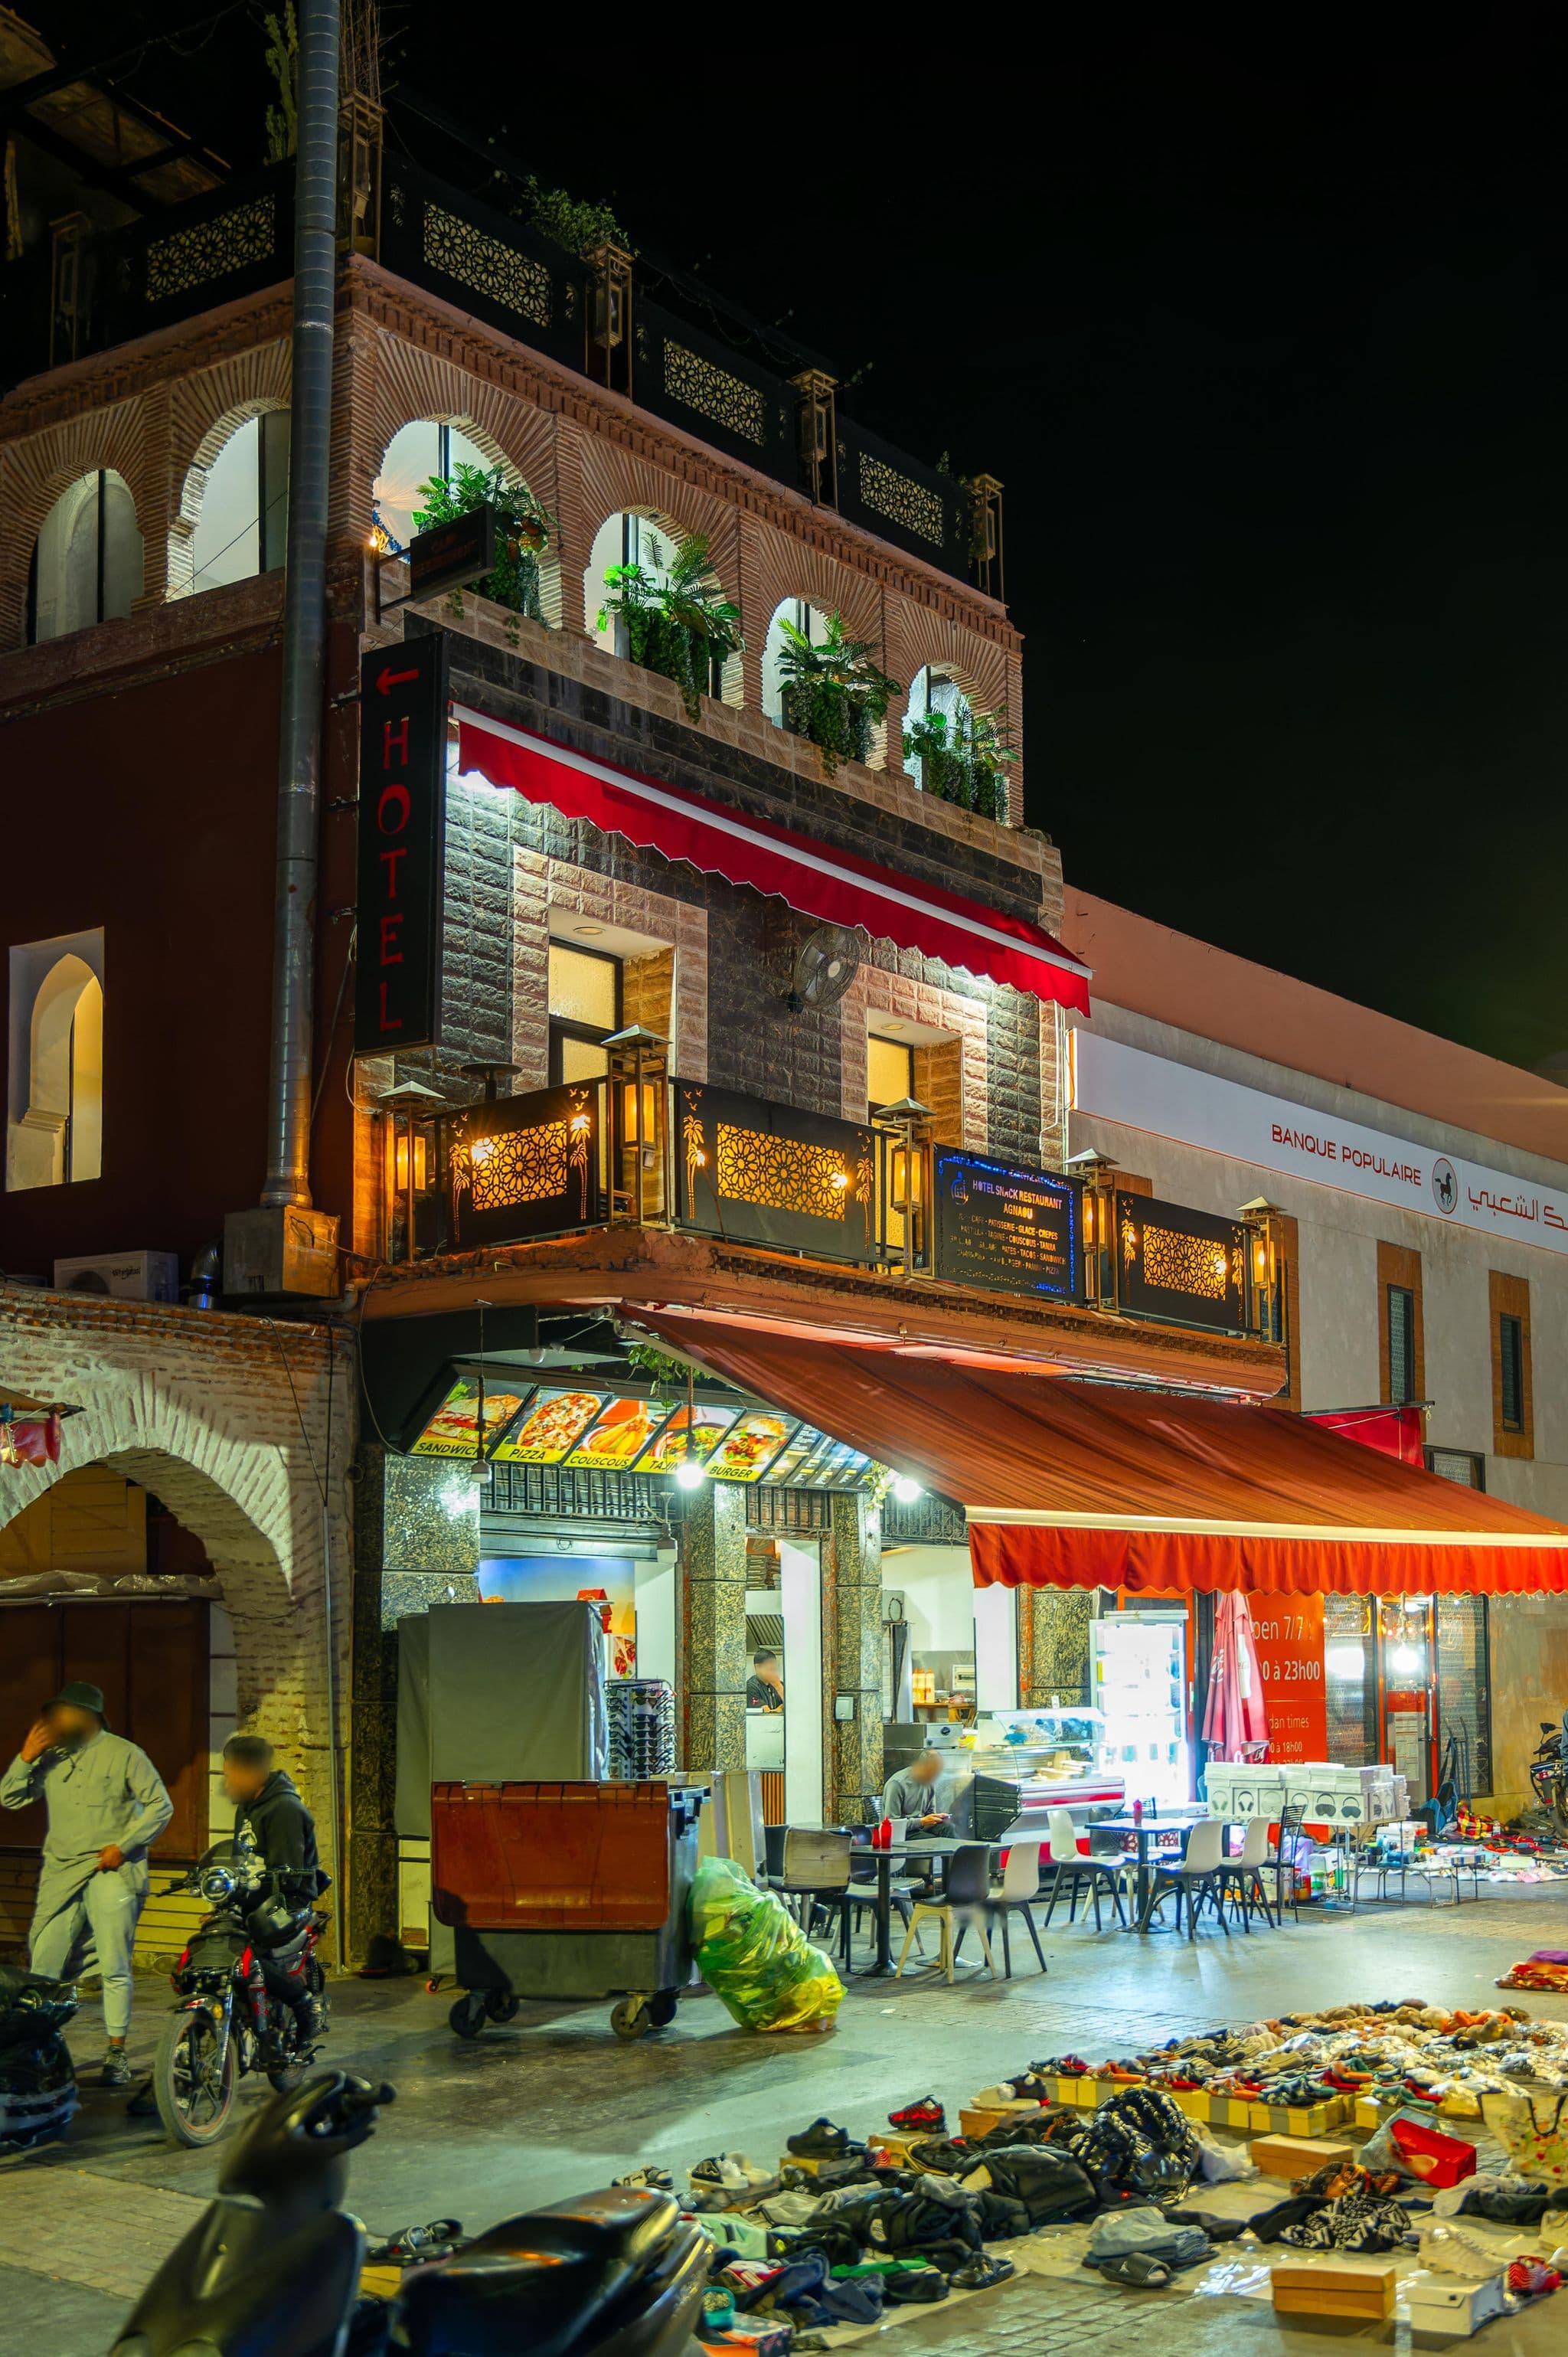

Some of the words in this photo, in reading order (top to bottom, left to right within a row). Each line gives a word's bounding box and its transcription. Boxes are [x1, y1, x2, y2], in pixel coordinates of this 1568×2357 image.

[377, 716, 411, 1031] HOTEL
[1272, 1124, 1336, 1160] BANQUE
[1341, 1146, 1422, 1186] POPULAIRE
[972, 1179, 995, 1195] HOTEL
[1018, 1190, 1063, 1210] RESTAURANT
[1003, 1203, 1033, 1219] AGNAOU
[1468, 1186, 1539, 1222] الشعبي
[1018, 1224, 1036, 1236] GLACE
[1038, 1228, 1058, 1241] CREPES
[1008, 1234, 1037, 1248] COUSCOUS
[1019, 1248, 1036, 1260] TACOS
[508, 1448, 546, 1460] PIZZA
[570, 1455, 628, 1467] COUSCOUS
[649, 1460, 679, 1471] TAJIN
[709, 1465, 753, 1479] BURGER
[1253, 1620, 1279, 1640] pen
[1284, 1659, 1321, 1681] 23h00
[1286, 1715, 1309, 1728] times
[1282, 1741, 1303, 1753] 18h00
